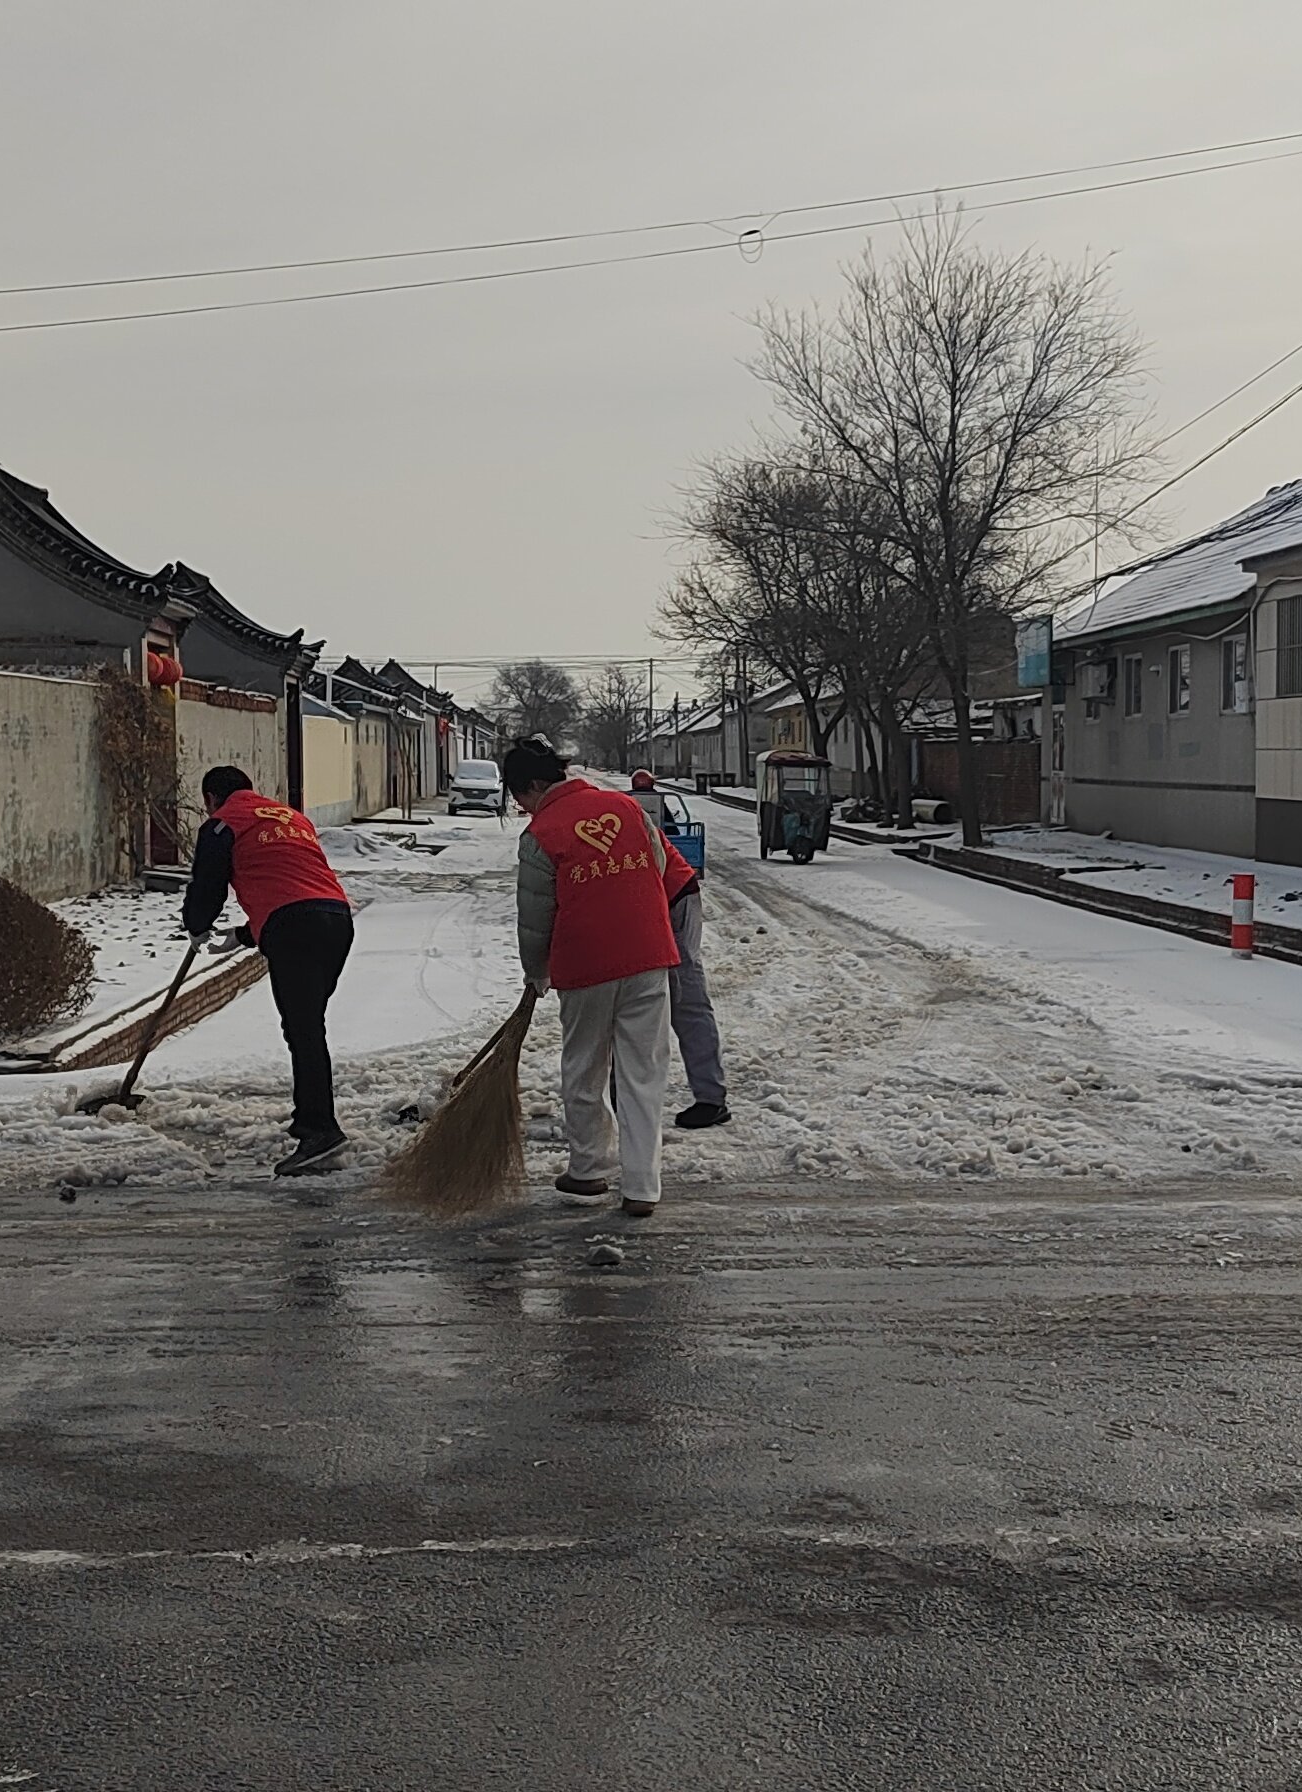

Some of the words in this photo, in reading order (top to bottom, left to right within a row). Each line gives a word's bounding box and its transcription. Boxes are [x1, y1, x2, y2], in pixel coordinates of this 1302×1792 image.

[570, 850, 650, 884] 党员志愿者
